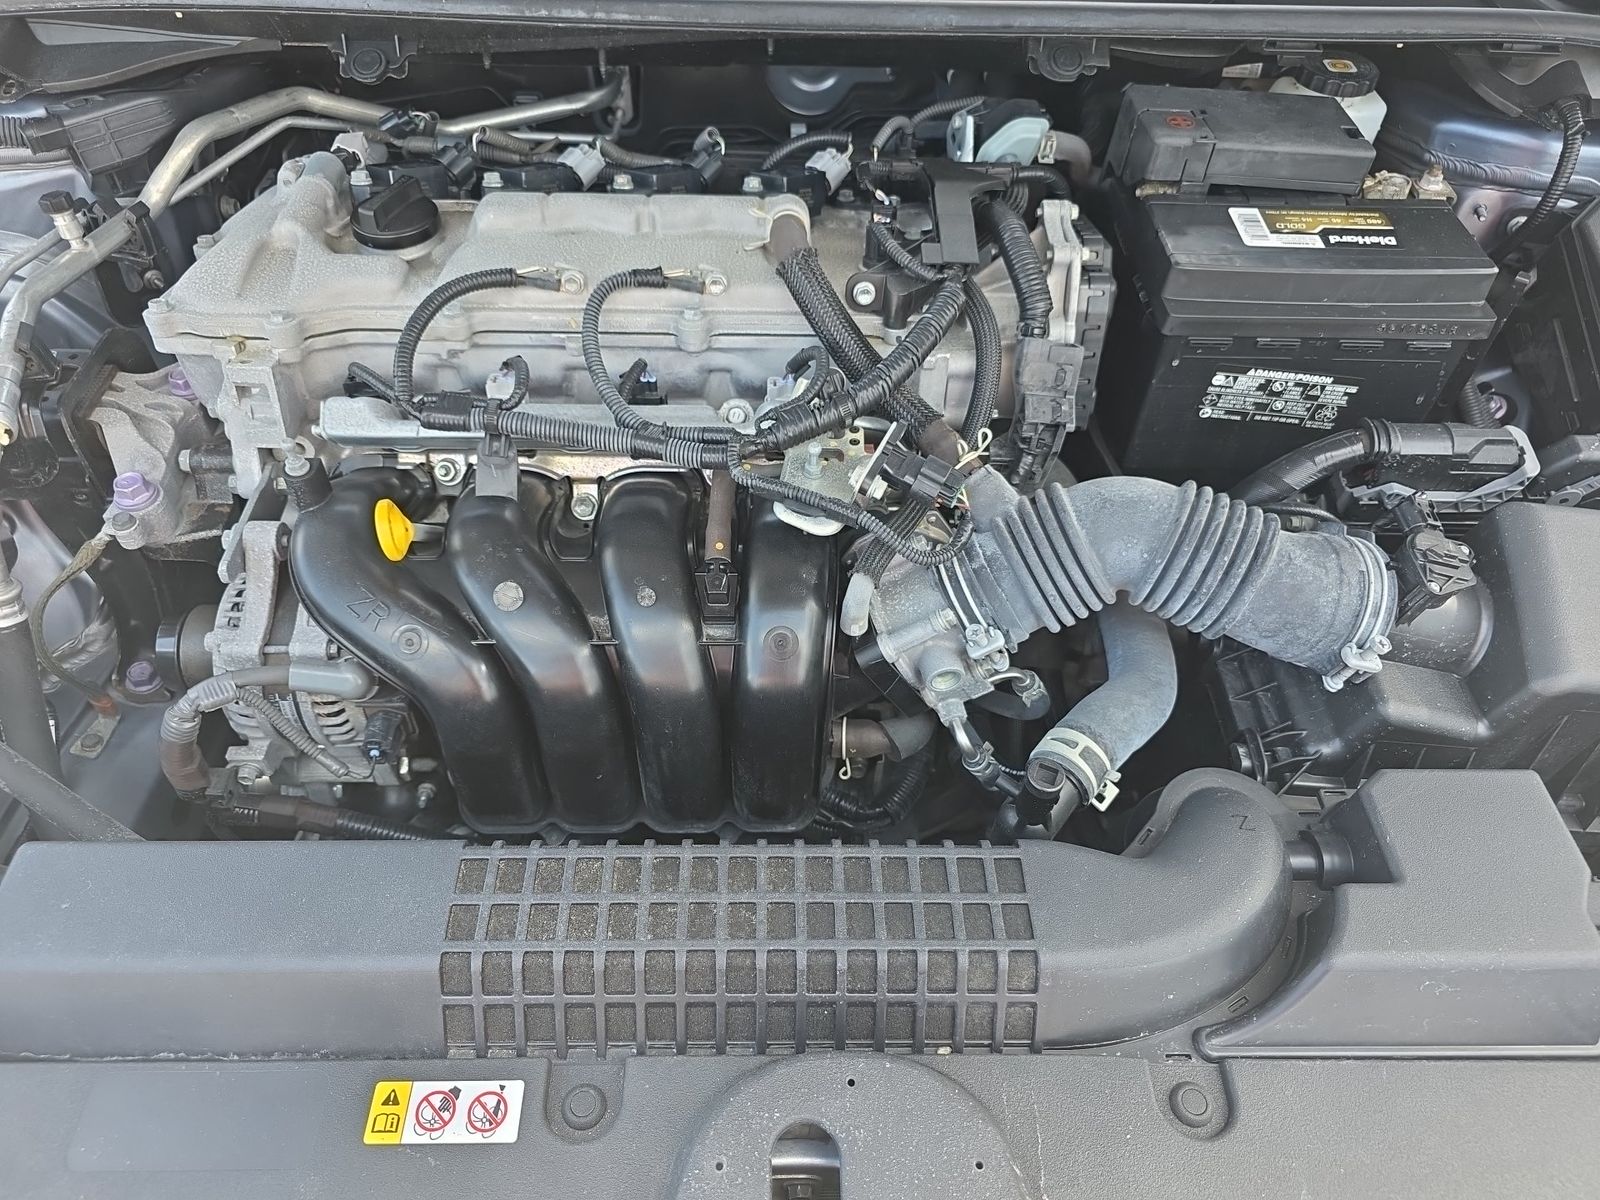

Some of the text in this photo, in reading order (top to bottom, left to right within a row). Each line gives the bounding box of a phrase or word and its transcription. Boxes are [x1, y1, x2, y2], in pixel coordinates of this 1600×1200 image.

[1328, 235, 1397, 245] DieHard
[1254, 369, 1334, 384] DANGER/POISON
[345, 586, 390, 632] ZR
